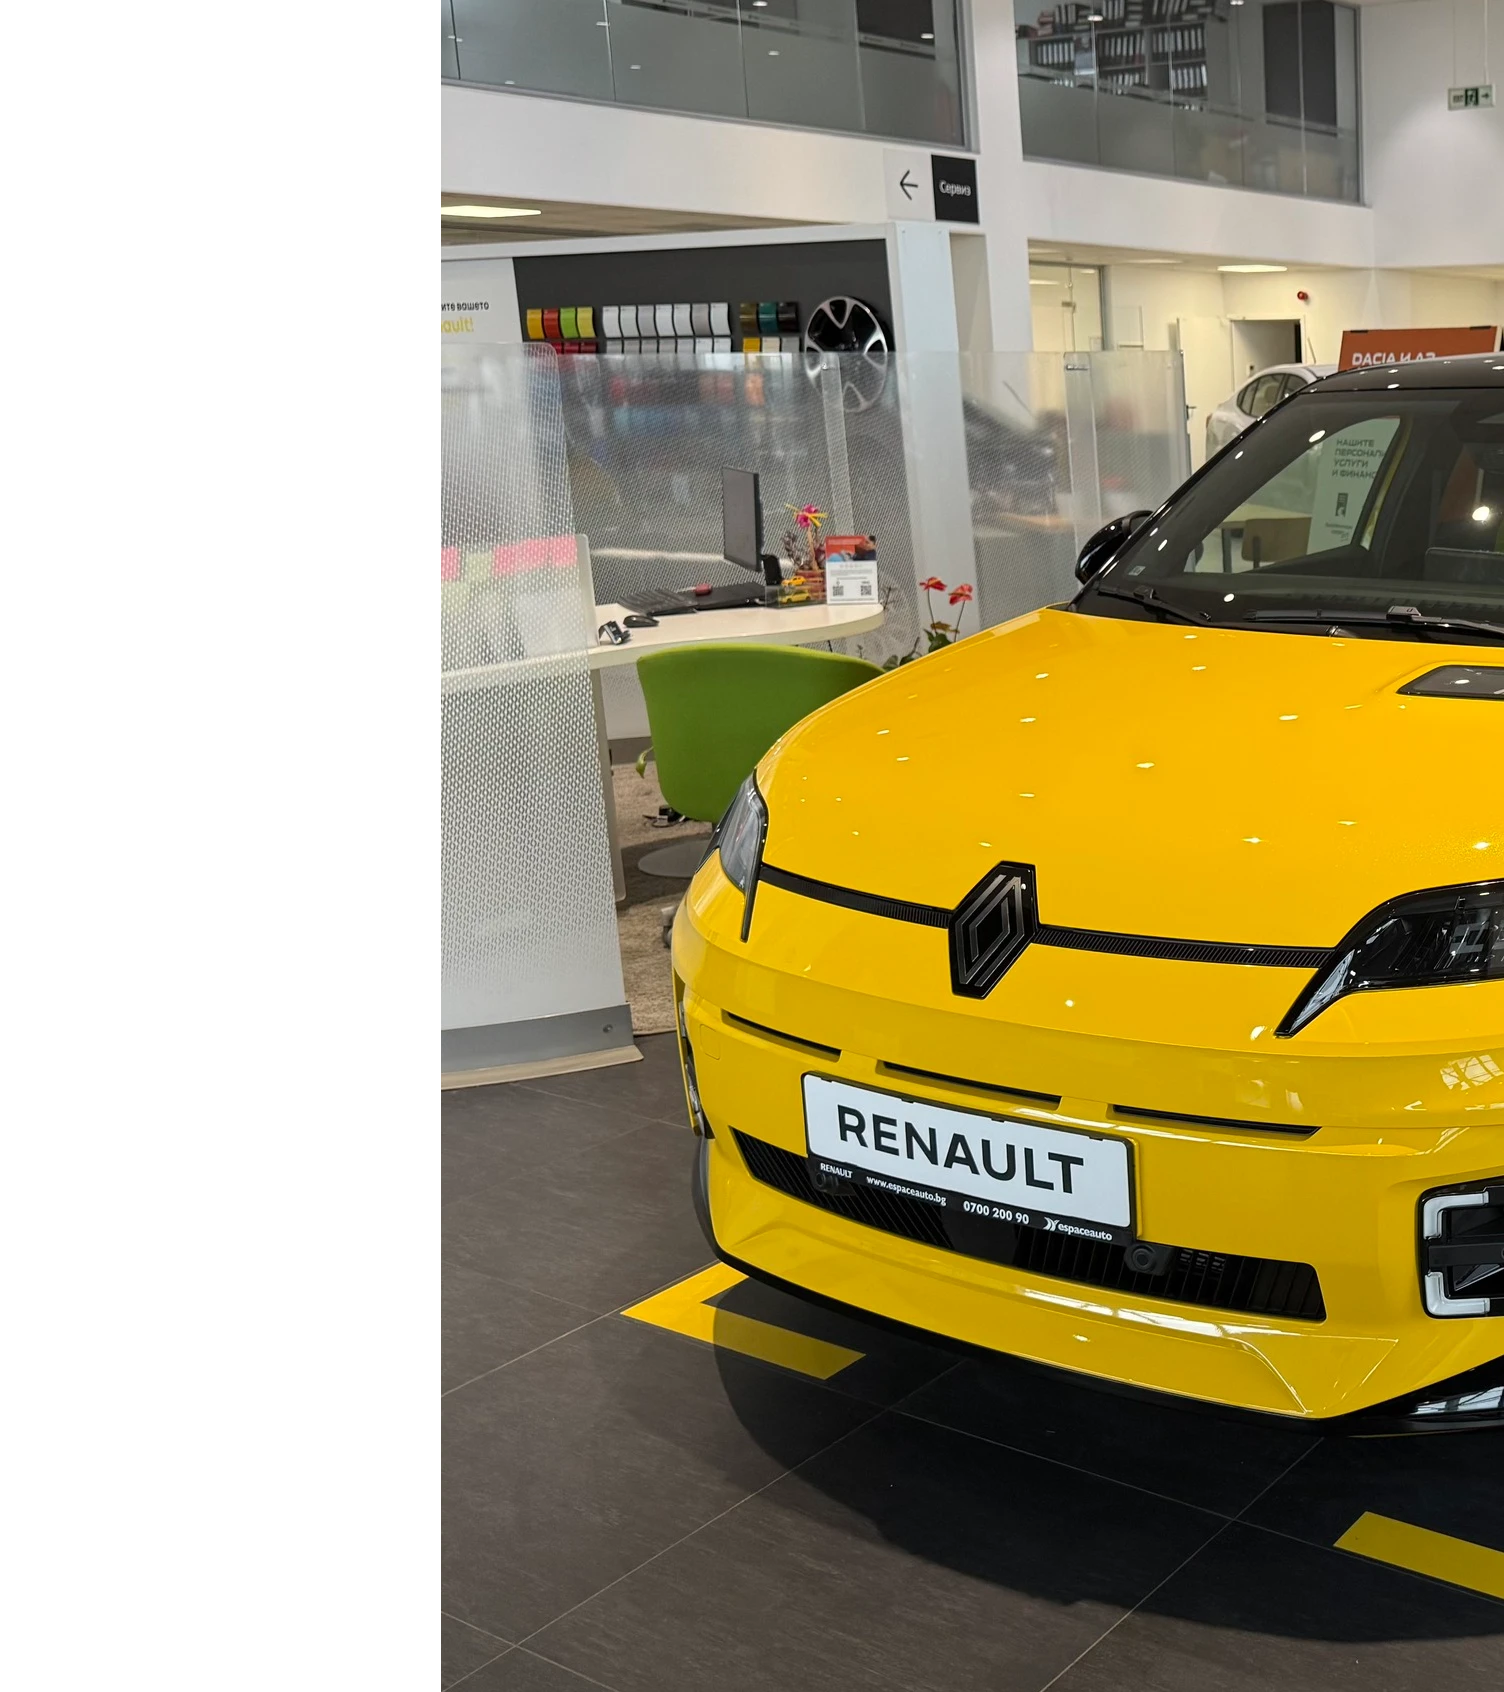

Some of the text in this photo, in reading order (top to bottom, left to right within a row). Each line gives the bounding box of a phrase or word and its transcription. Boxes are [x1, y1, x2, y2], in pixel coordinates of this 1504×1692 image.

[939, 180, 972, 197] Сервиз
[440, 302, 456, 311] ите
[440, 316, 474, 334] ault!
[1352, 352, 1396, 366] DACIA
[1336, 439, 1375, 447] НАШИТЕ
[1334, 459, 1369, 468] УСЛУГИ
[837, 1104, 1084, 1194] RENAULT
[820, 1162, 1113, 1241] RENAULT www.espaceauto.bg 0700 200 90 espaceauto
